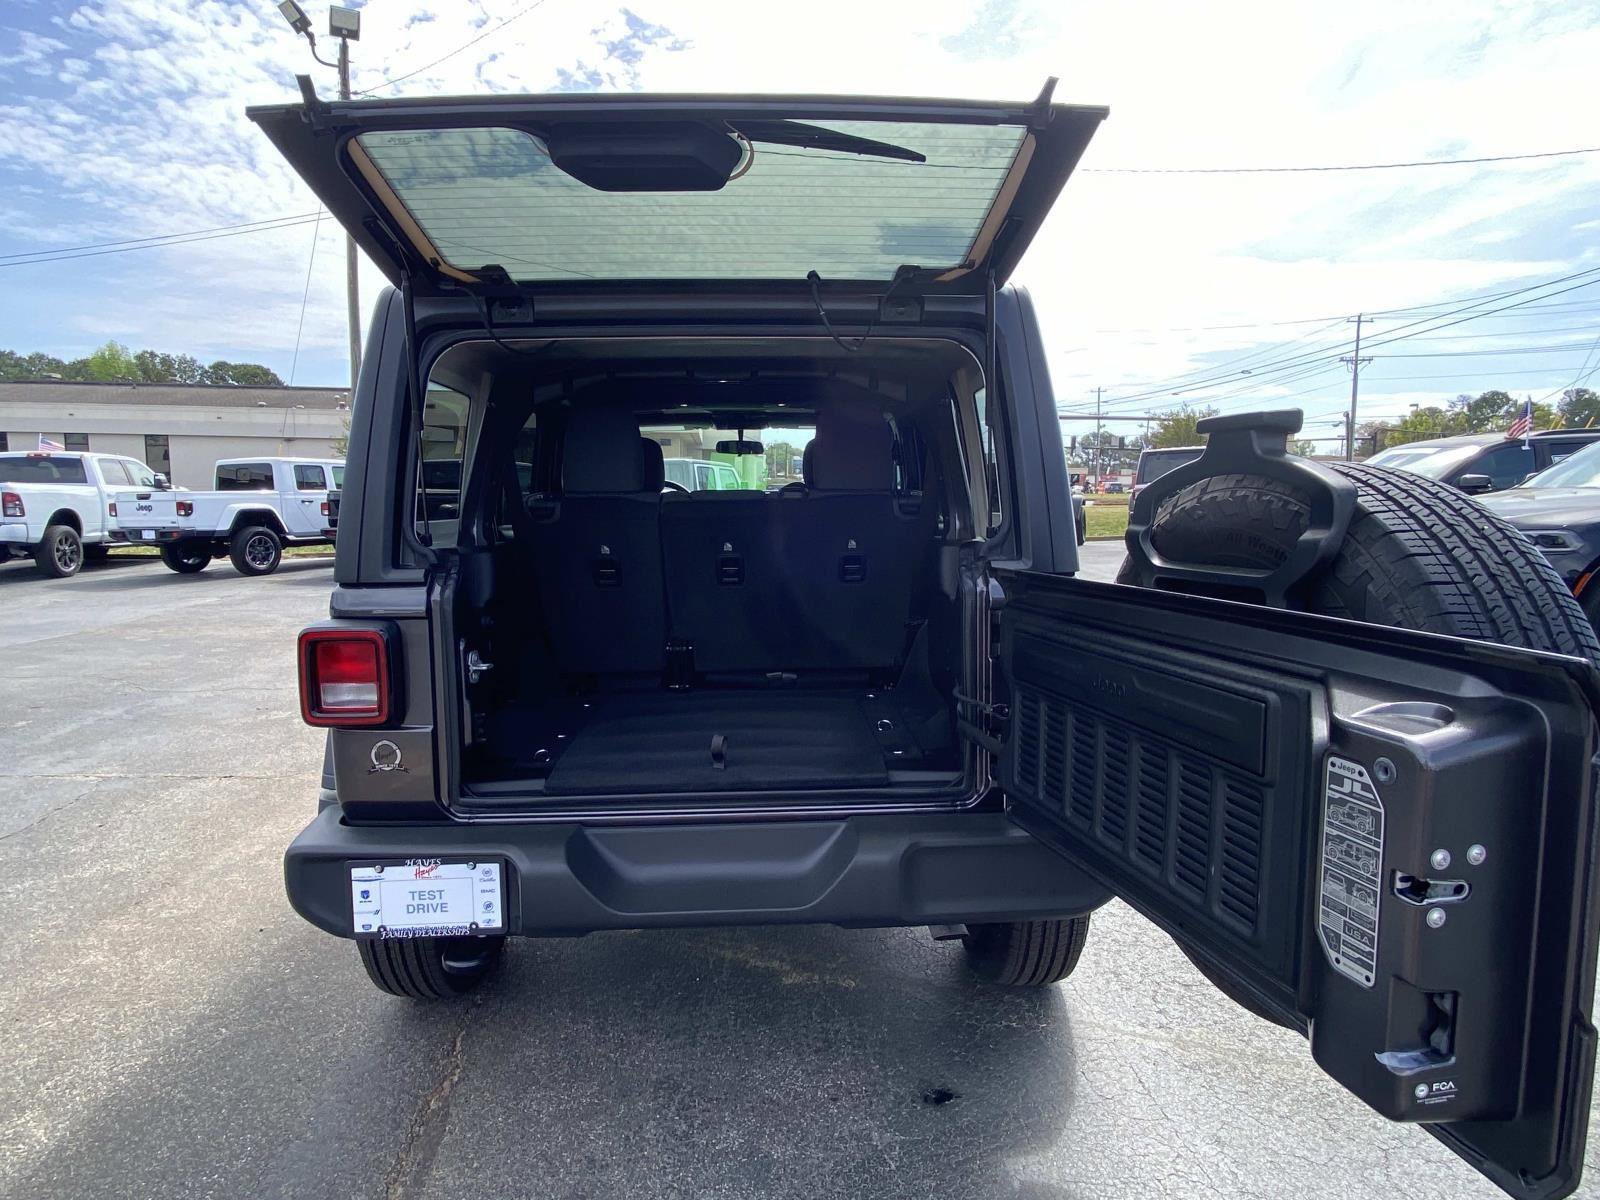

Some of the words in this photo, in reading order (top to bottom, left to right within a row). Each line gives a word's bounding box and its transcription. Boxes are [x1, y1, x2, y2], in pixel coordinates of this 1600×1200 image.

[136, 503, 153, 512] Jeep
[1337, 762, 1356, 775] Jeep
[1329, 778, 1375, 800] JL
[408, 889, 445, 901] TEST
[406, 902, 449, 914] DRIVE
[1345, 926, 1372, 947] USA
[1432, 1081, 1456, 1092] FCA
